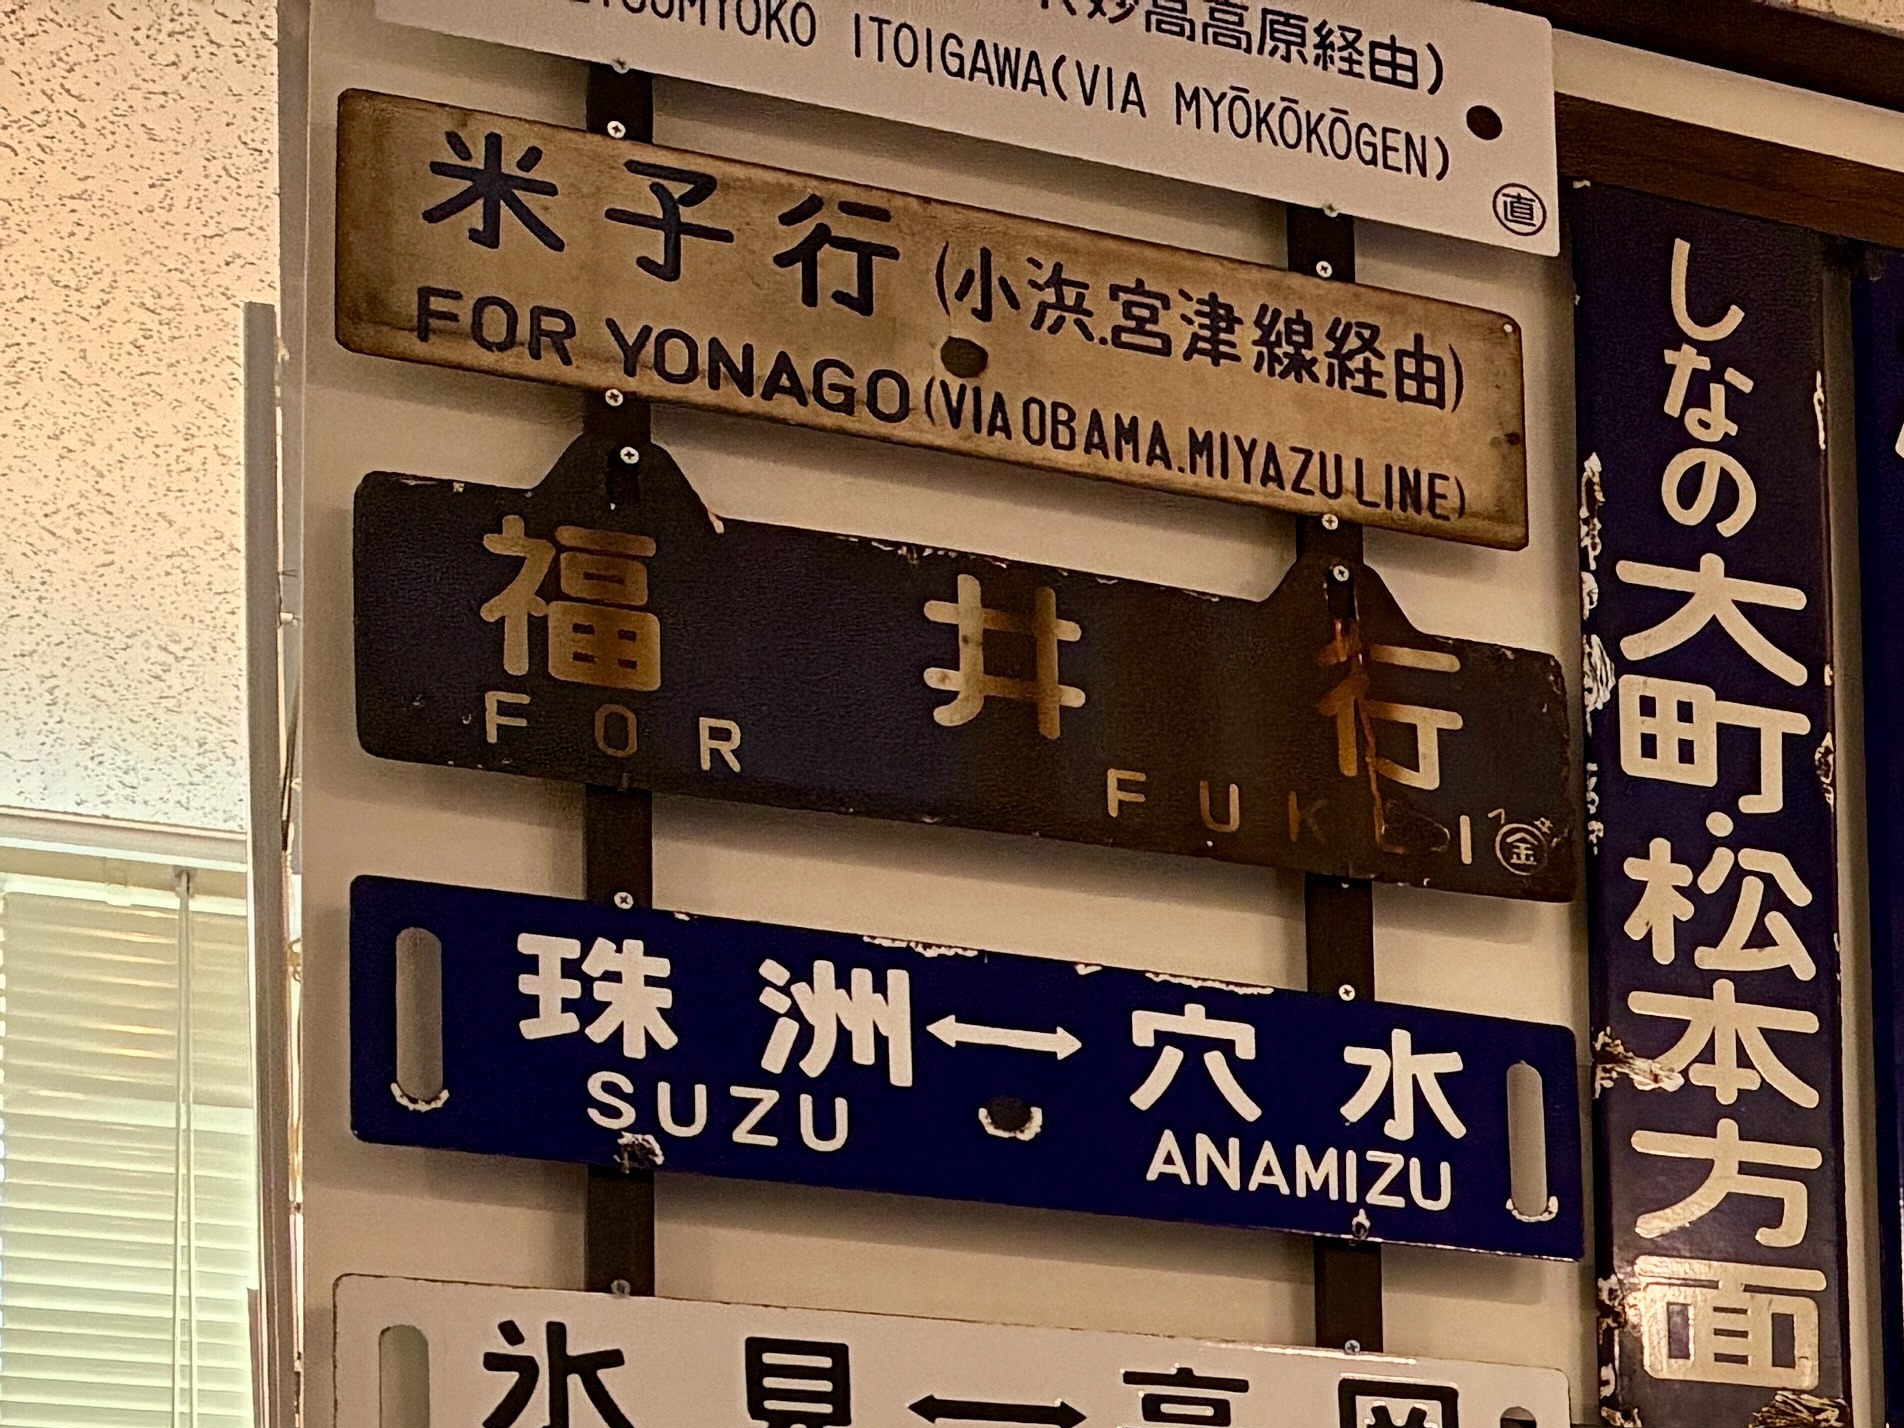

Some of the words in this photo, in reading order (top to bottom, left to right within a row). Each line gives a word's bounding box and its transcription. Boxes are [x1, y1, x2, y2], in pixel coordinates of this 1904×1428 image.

[1174, 80, 1450, 182] MYŌKŌKŌGEN)
[421, 128, 901, 316] 米子行
[415, 286, 577, 370] FOR
[606, 317, 912, 426] YONAGO
[480, 515, 1463, 794] 福井行
[483, 690, 744, 775] FOR
[516, 932, 916, 1091] 珠洲
[1127, 1002, 1467, 1142] 穴水
[586, 1069, 850, 1153] SUZU
[1145, 1128, 1453, 1213] ANAMIZU
